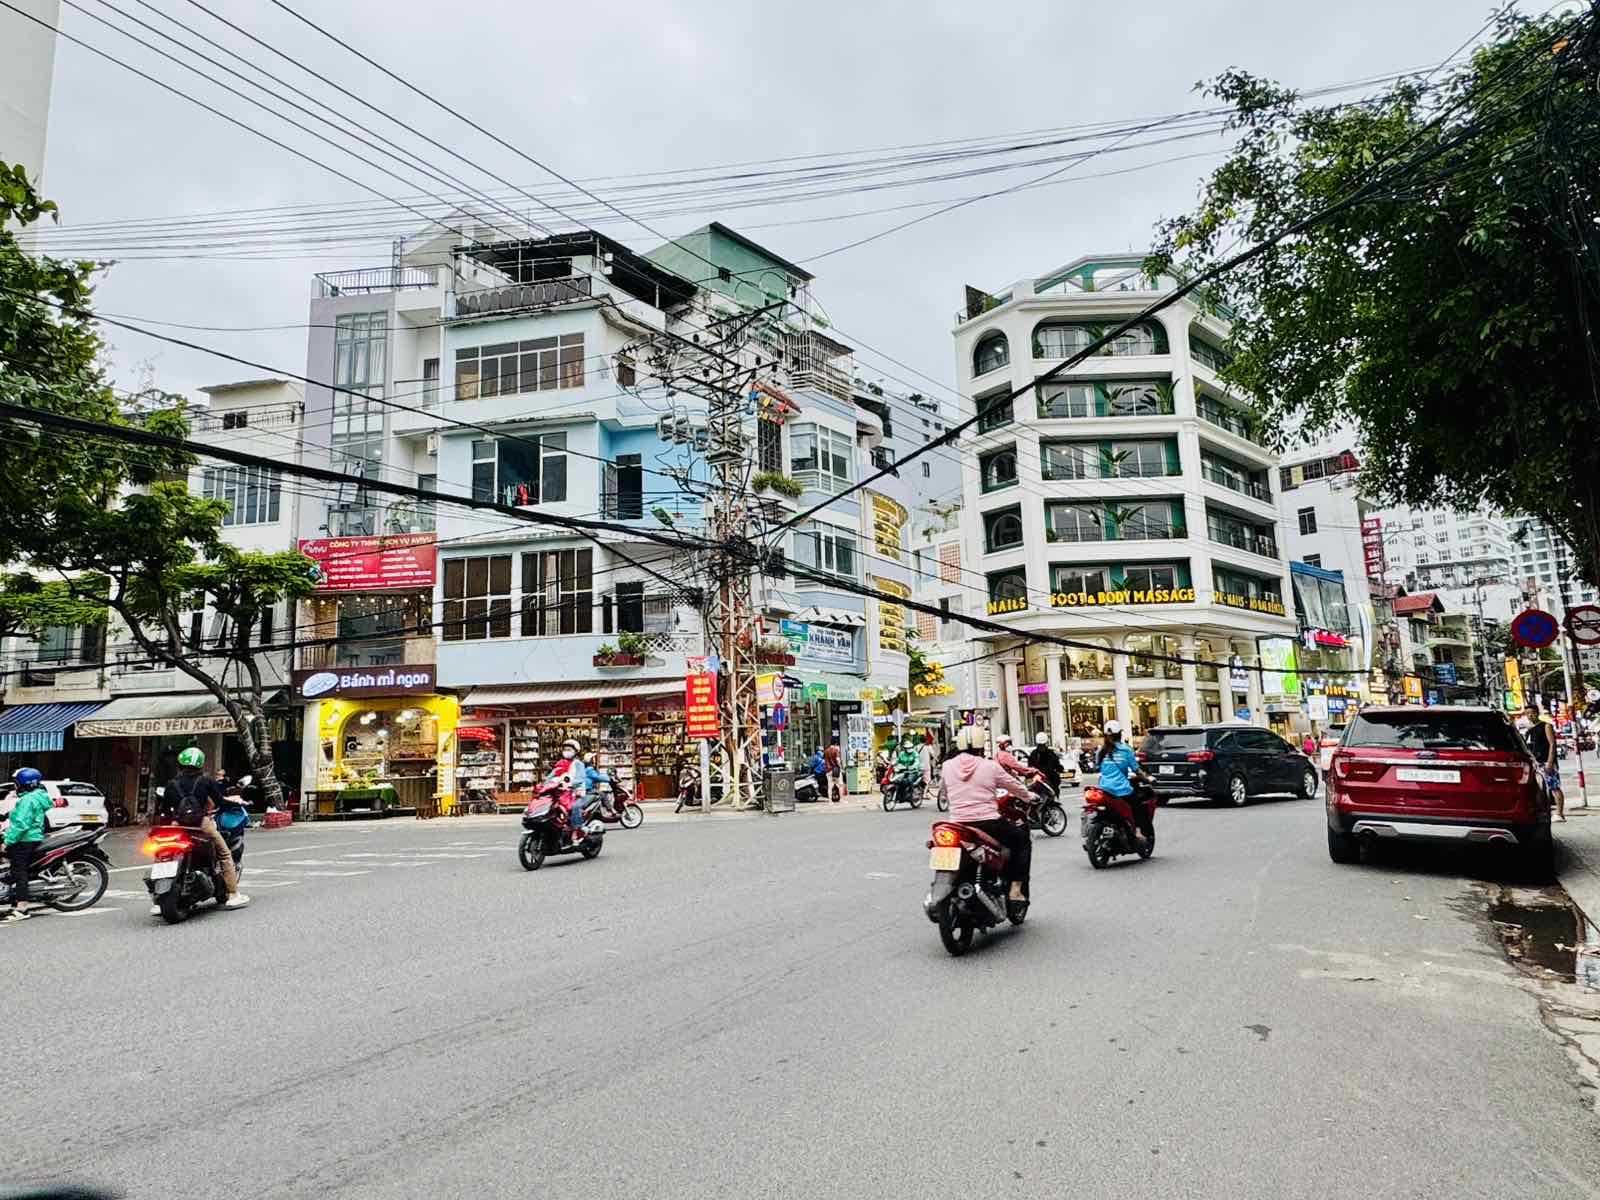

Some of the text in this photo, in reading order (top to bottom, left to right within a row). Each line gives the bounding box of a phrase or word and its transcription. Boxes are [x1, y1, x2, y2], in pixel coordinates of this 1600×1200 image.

[329, 540, 350, 548] CÔNG
[987, 596, 1026, 614] NAILS
[1050, 593, 1086, 605] FOOT
[1097, 590, 1131, 604] BODY
[1133, 588, 1195, 602] MASSAGE
[341, 673, 375, 688] Bánh
[377, 669, 395, 686] mì
[397, 673, 429, 688] ngon
[191, 719, 209, 730] XE
